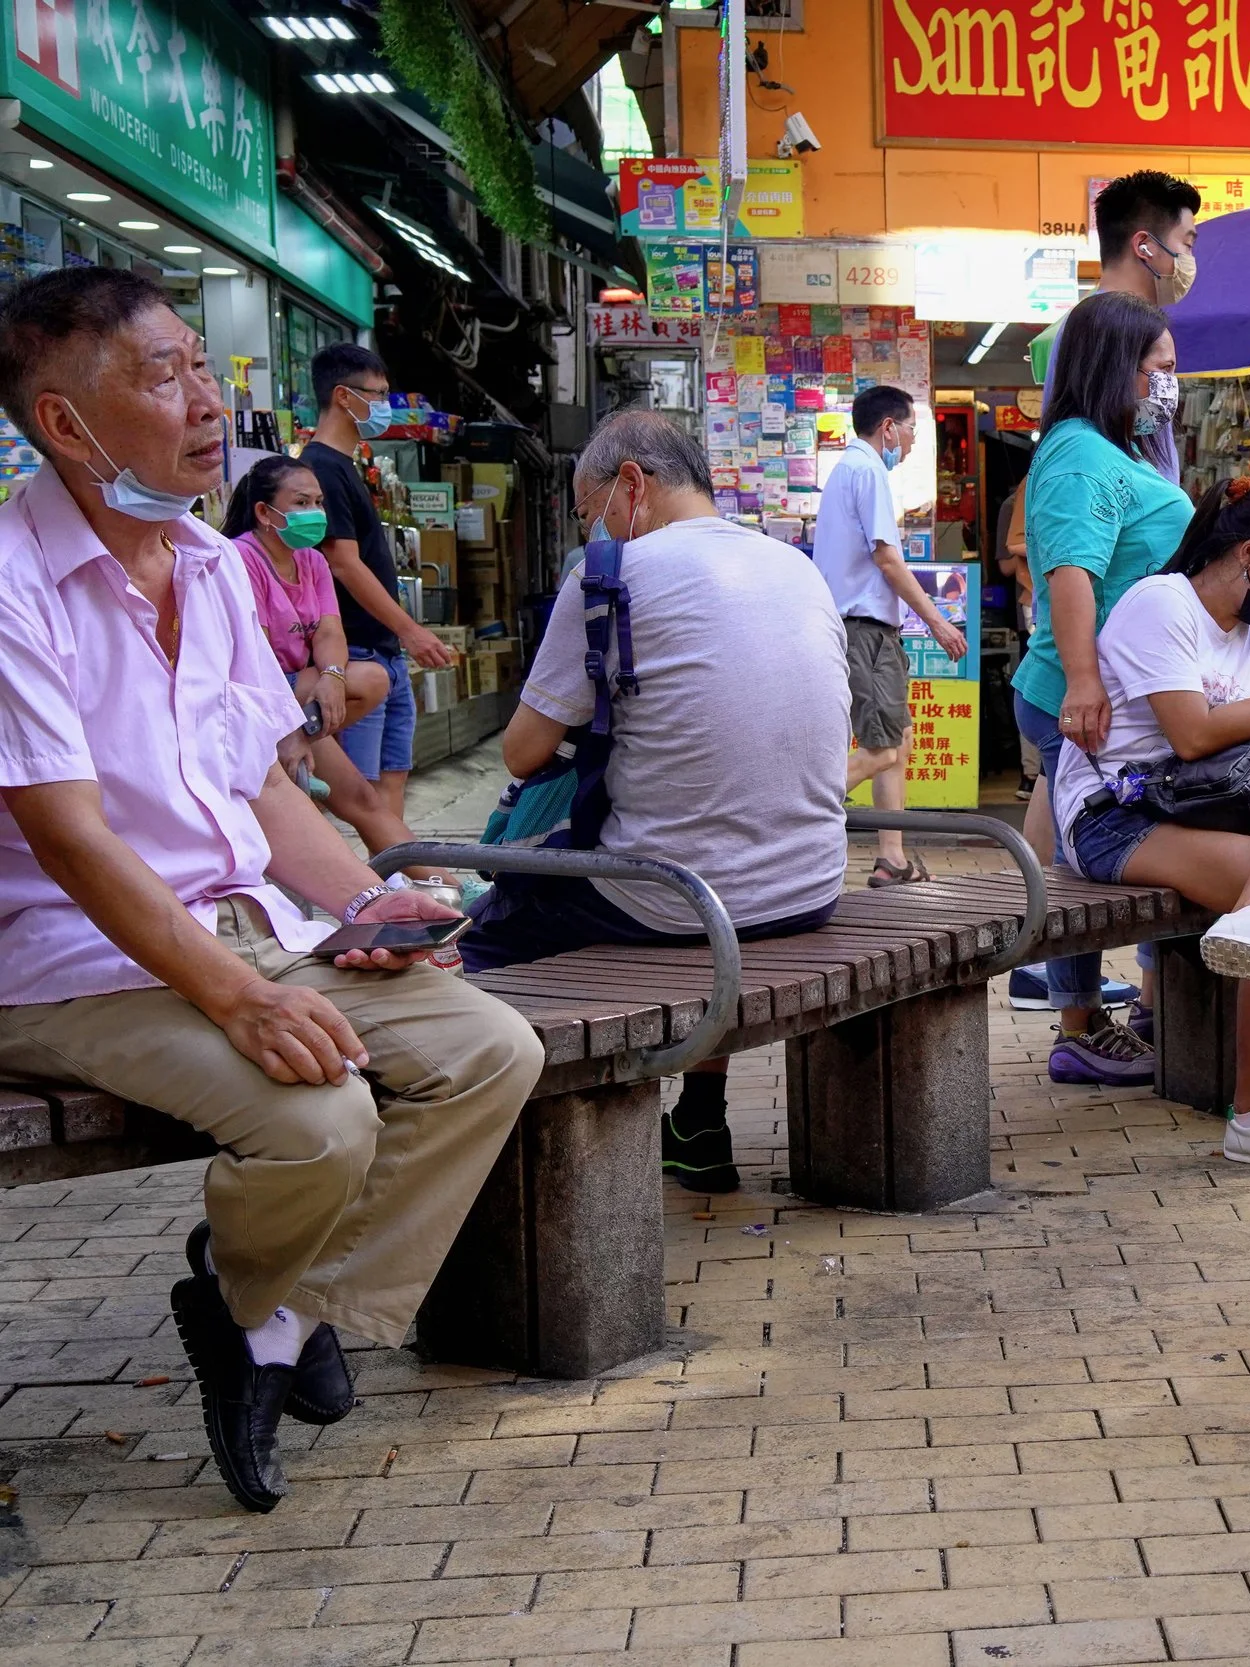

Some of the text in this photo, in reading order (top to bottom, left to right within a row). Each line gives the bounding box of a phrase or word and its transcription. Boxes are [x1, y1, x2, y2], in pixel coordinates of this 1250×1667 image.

[89, 87, 267, 228] WONDERFUL DISPENSARY LIMITED
[846, 265, 899, 287] 4289
[911, 682, 935, 700] 訊
[912, 737, 951, 751] 觸屏
[924, 752, 970, 766] 充值卡
